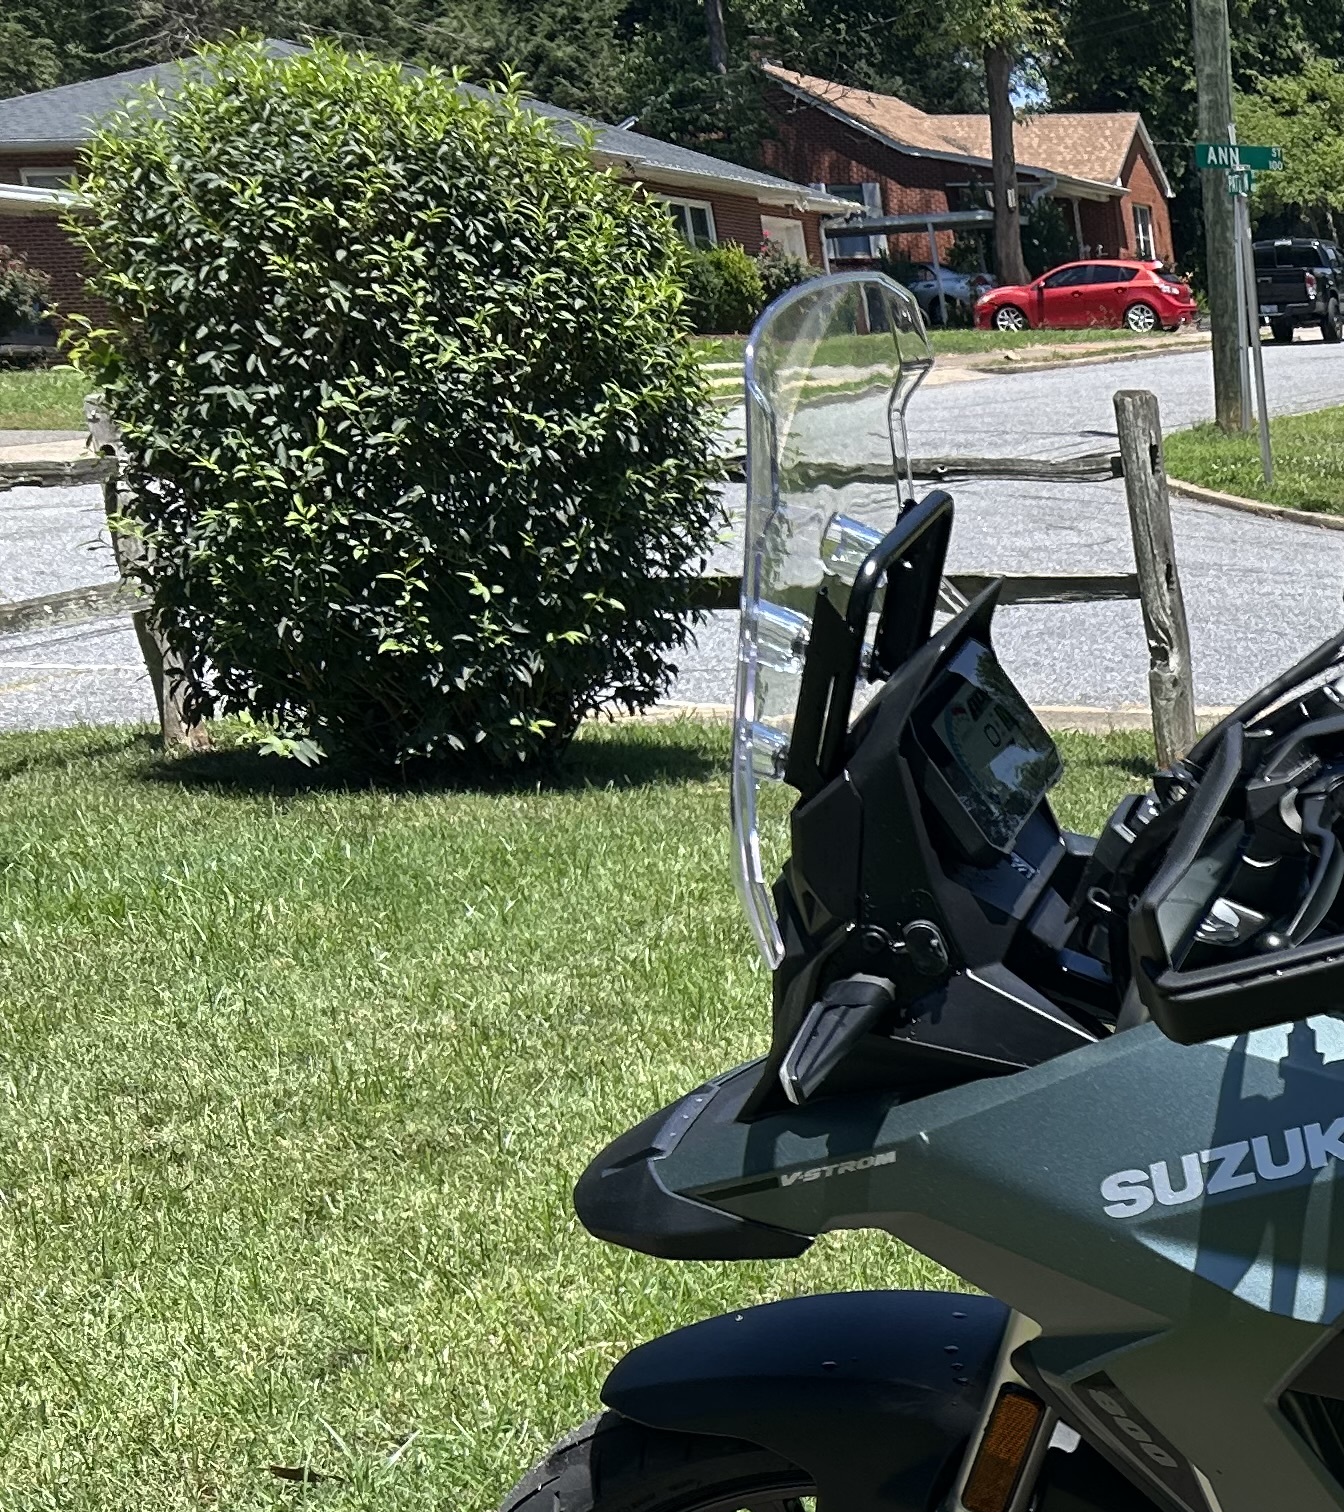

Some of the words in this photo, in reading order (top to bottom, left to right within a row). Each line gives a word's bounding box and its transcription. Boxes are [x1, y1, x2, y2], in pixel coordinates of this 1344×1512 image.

[1207, 146, 1240, 166] ANN
[1271, 148, 1281, 158] ST
[1268, 160, 1283, 171] 100
[780, 1150, 897, 1187] V-STROM
[1087, 1388, 1179, 1468] 800
